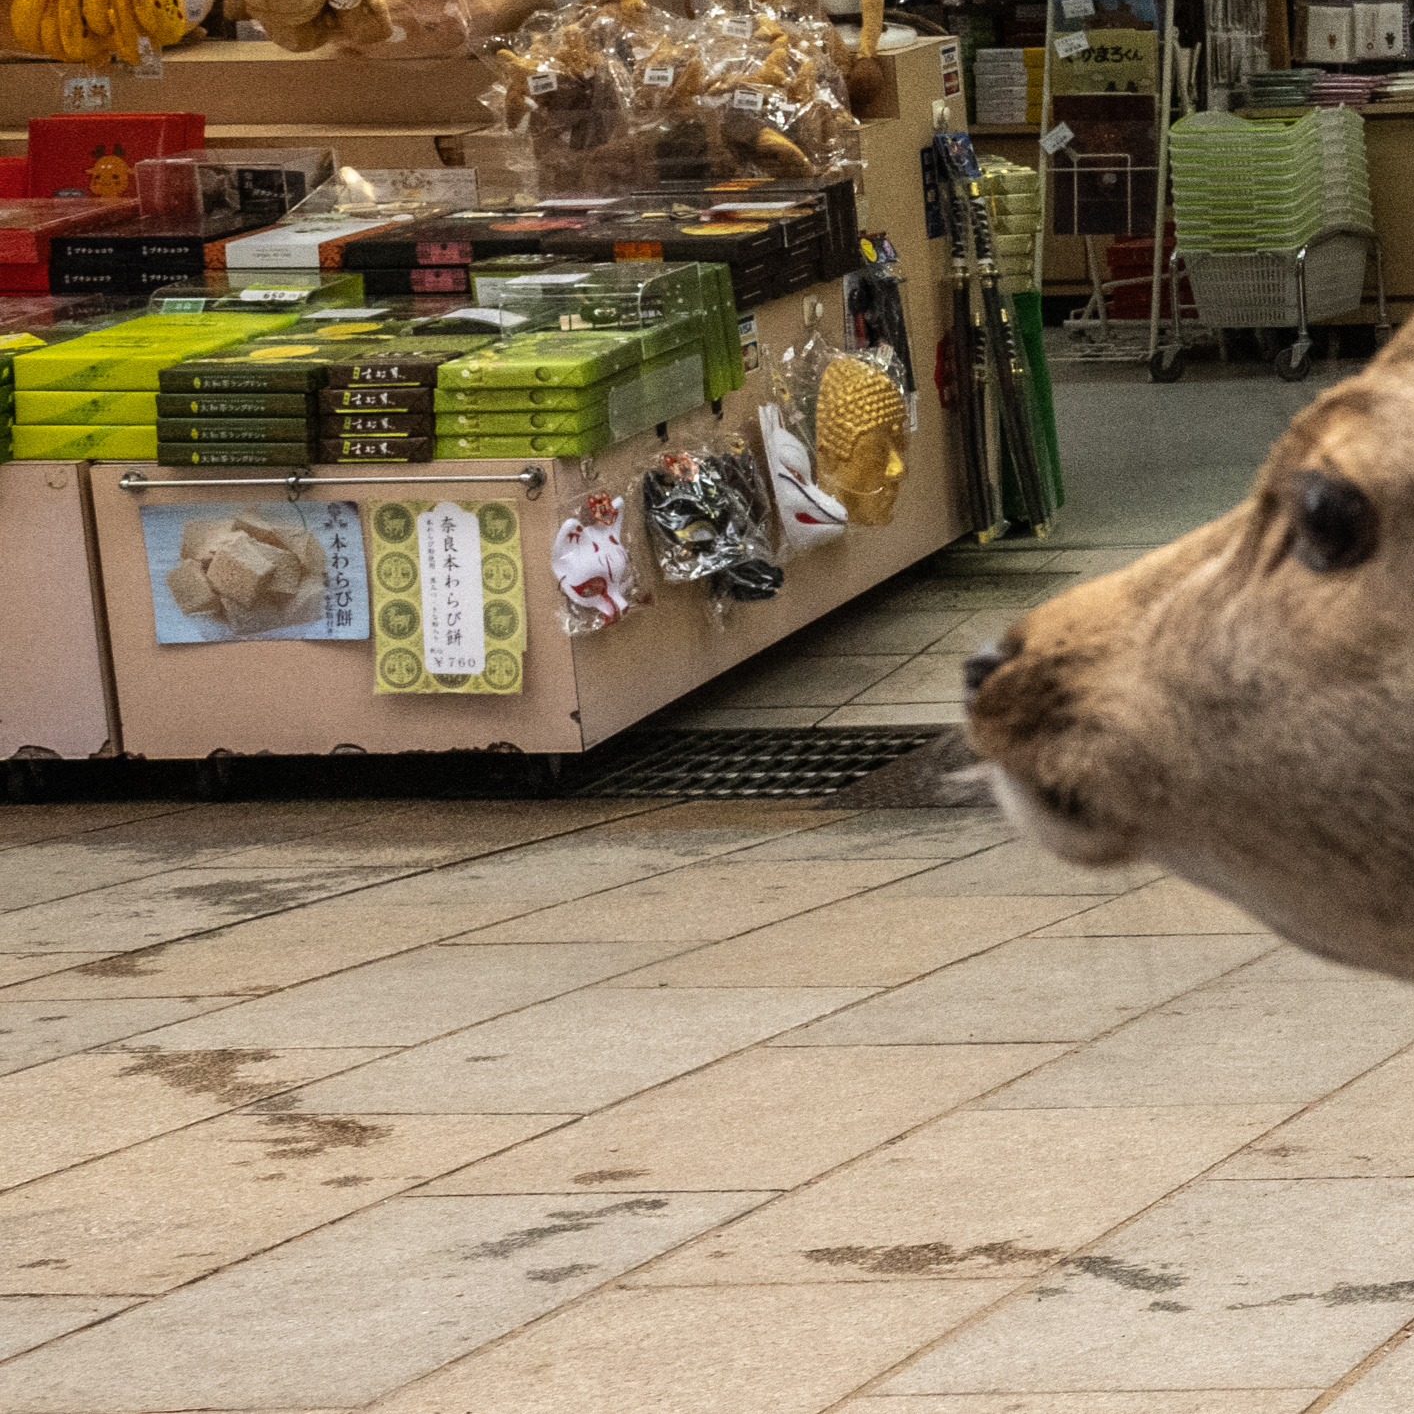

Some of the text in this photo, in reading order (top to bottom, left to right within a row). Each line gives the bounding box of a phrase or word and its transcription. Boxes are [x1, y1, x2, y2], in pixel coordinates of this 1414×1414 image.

[330, 532, 353, 628] 本わらび餅
[440, 515, 463, 647] 奈良本わらび餅
[433, 657, 477, 669] ¥760
